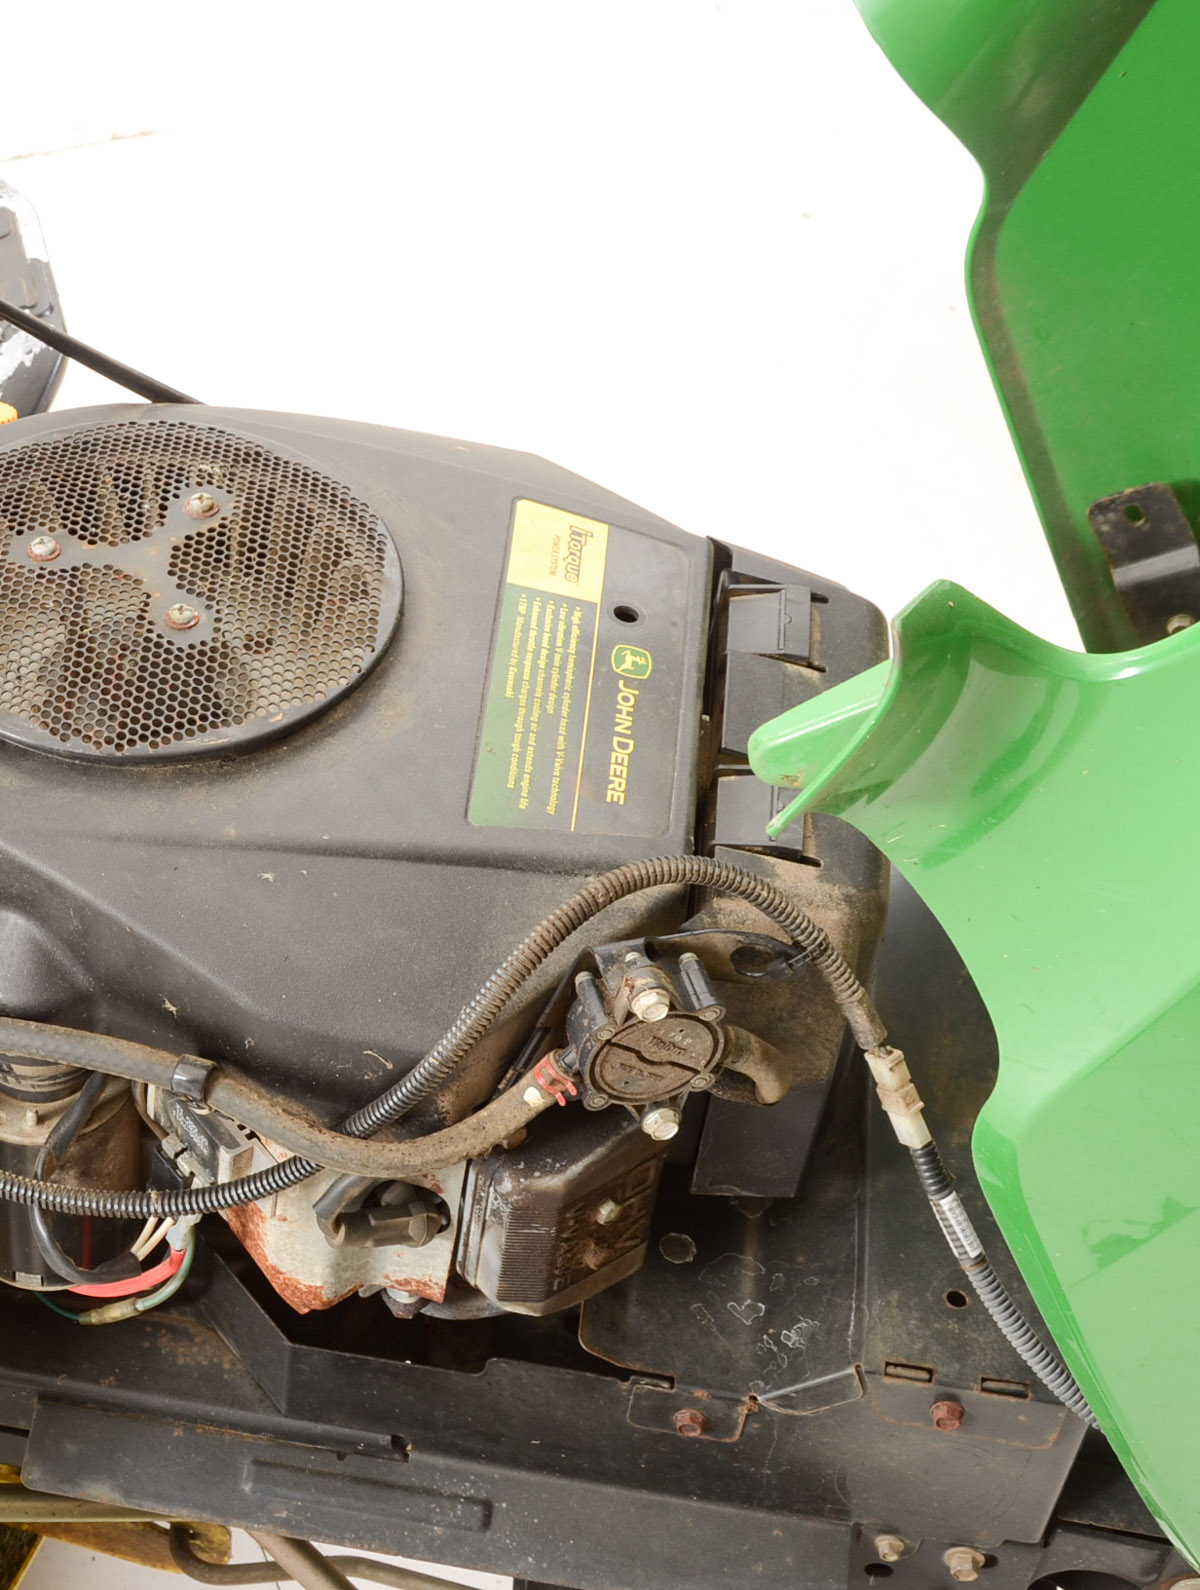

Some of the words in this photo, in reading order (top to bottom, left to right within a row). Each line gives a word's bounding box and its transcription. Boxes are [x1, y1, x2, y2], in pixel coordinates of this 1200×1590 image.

[505, 666, 517, 698] Kawasaki
[529, 697, 541, 722] cooling
[545, 691, 557, 714] design
[613, 678, 639, 735] JOHN
[513, 706, 526, 732] through
[558, 717, 569, 735] head
[528, 732, 537, 745] and
[506, 752, 519, 788] conditions
[523, 745, 535, 773] extends
[605, 735, 634, 806] DEERE
[518, 772, 531, 797] engine
[545, 776, 560, 815] technology
[518, 797, 528, 810] life
